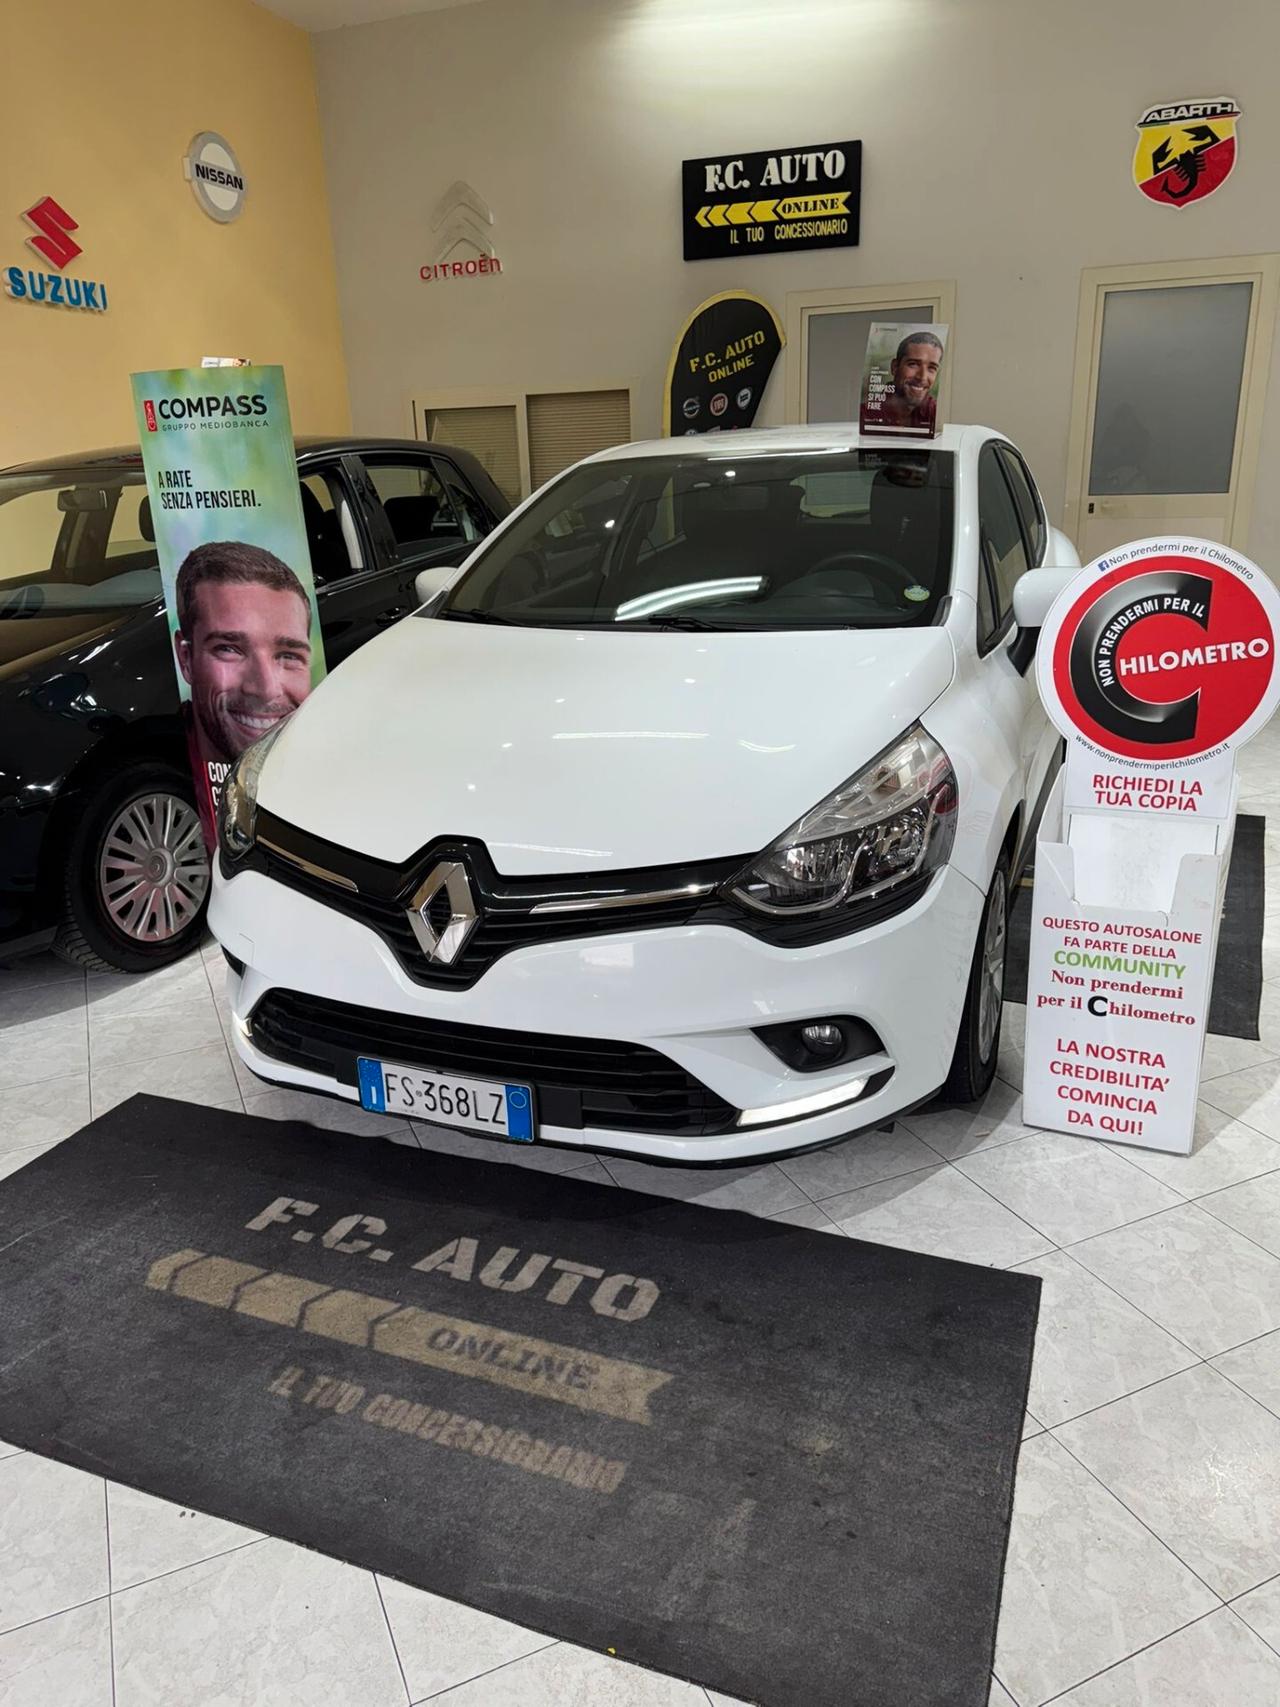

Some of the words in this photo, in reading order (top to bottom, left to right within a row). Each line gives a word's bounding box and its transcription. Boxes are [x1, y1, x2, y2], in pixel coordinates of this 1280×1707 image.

[1146, 104, 1232, 123] ABARTH
[195, 163, 244, 191] NISSAN
[704, 160, 751, 192] F.C.
[760, 149, 846, 186] AUTO
[782, 198, 840, 214] ONLINE
[730, 229, 740, 244] IL
[746, 226, 765, 242] TUO
[774, 218, 848, 240] CONCESSIONARIO
[6, 266, 108, 311] SUZUKI
[689, 352, 721, 373] F.C.
[725, 330, 765, 360] AUTO
[708, 353, 755, 383] ONLINE
[869, 375, 882, 383] CON
[868, 384, 896, 393] COMPASS
[158, 395, 268, 420] COMPASS
[867, 402, 882, 410] FARE
[162, 423, 197, 432] GRUPPO
[200, 420, 269, 430] MEDIOBANCA
[158, 471, 166, 489] A
[166, 470, 193, 488] RATE
[161, 491, 193, 510] SENZA
[195, 489, 262, 510] PENSIERI.
[1108, 553, 1129, 567] Non
[1130, 543, 1181, 559] prendermi
[1182, 544, 1199, 554] per
[1200, 546, 1208, 555] il
[1208, 548, 1255, 581] Chilometro
[1163, 597, 1189, 611] PER
[1192, 602, 1207, 618] IL
[1098, 597, 1160, 656] PRENDERMI
[1097, 658, 1115, 688] NON
[1075, 734, 1231, 771] www.nonprendermiperilchilometro.it
[1092, 774, 1174, 794] RICHIEDI
[1180, 780, 1203, 796] LA
[1095, 790, 1133, 807] TUA
[1138, 794, 1197, 812] COPIA
[1042, 916, 1100, 933] QUESTO
[1103, 923, 1203, 945] AUTOSALONE
[1063, 936, 1081, 949] FA
[1084, 938, 1128, 954] PARTE
[1132, 944, 1177, 960] DELLA
[1053, 949, 1187, 980] COMMUNITY
[1050, 969, 1085, 986] Non
[1089, 977, 1184, 1000] prendermi
[1036, 994, 1066, 1008] per
[1069, 996, 1083, 1010] il
[1087, 995, 1196, 1026] Chilometro
[1056, 1038, 1080, 1056] LA
[1085, 1043, 1167, 1069] NOSTRA
[1049, 1060, 1170, 1093] CREDIBILITA'
[1057, 1085, 1158, 1115] COMINCIA
[1067, 1110, 1094, 1127] DA
[1099, 1115, 1144, 1136] QUI!
[245, 1196, 394, 1262] F.C.
[412, 1236, 662, 1323] AUTO
[427, 1326, 601, 1394] ONLINE
[268, 1366, 304, 1398] IL
[303, 1373, 364, 1416] TUO
[365, 1393, 628, 1495] CONCESSIONARIO
